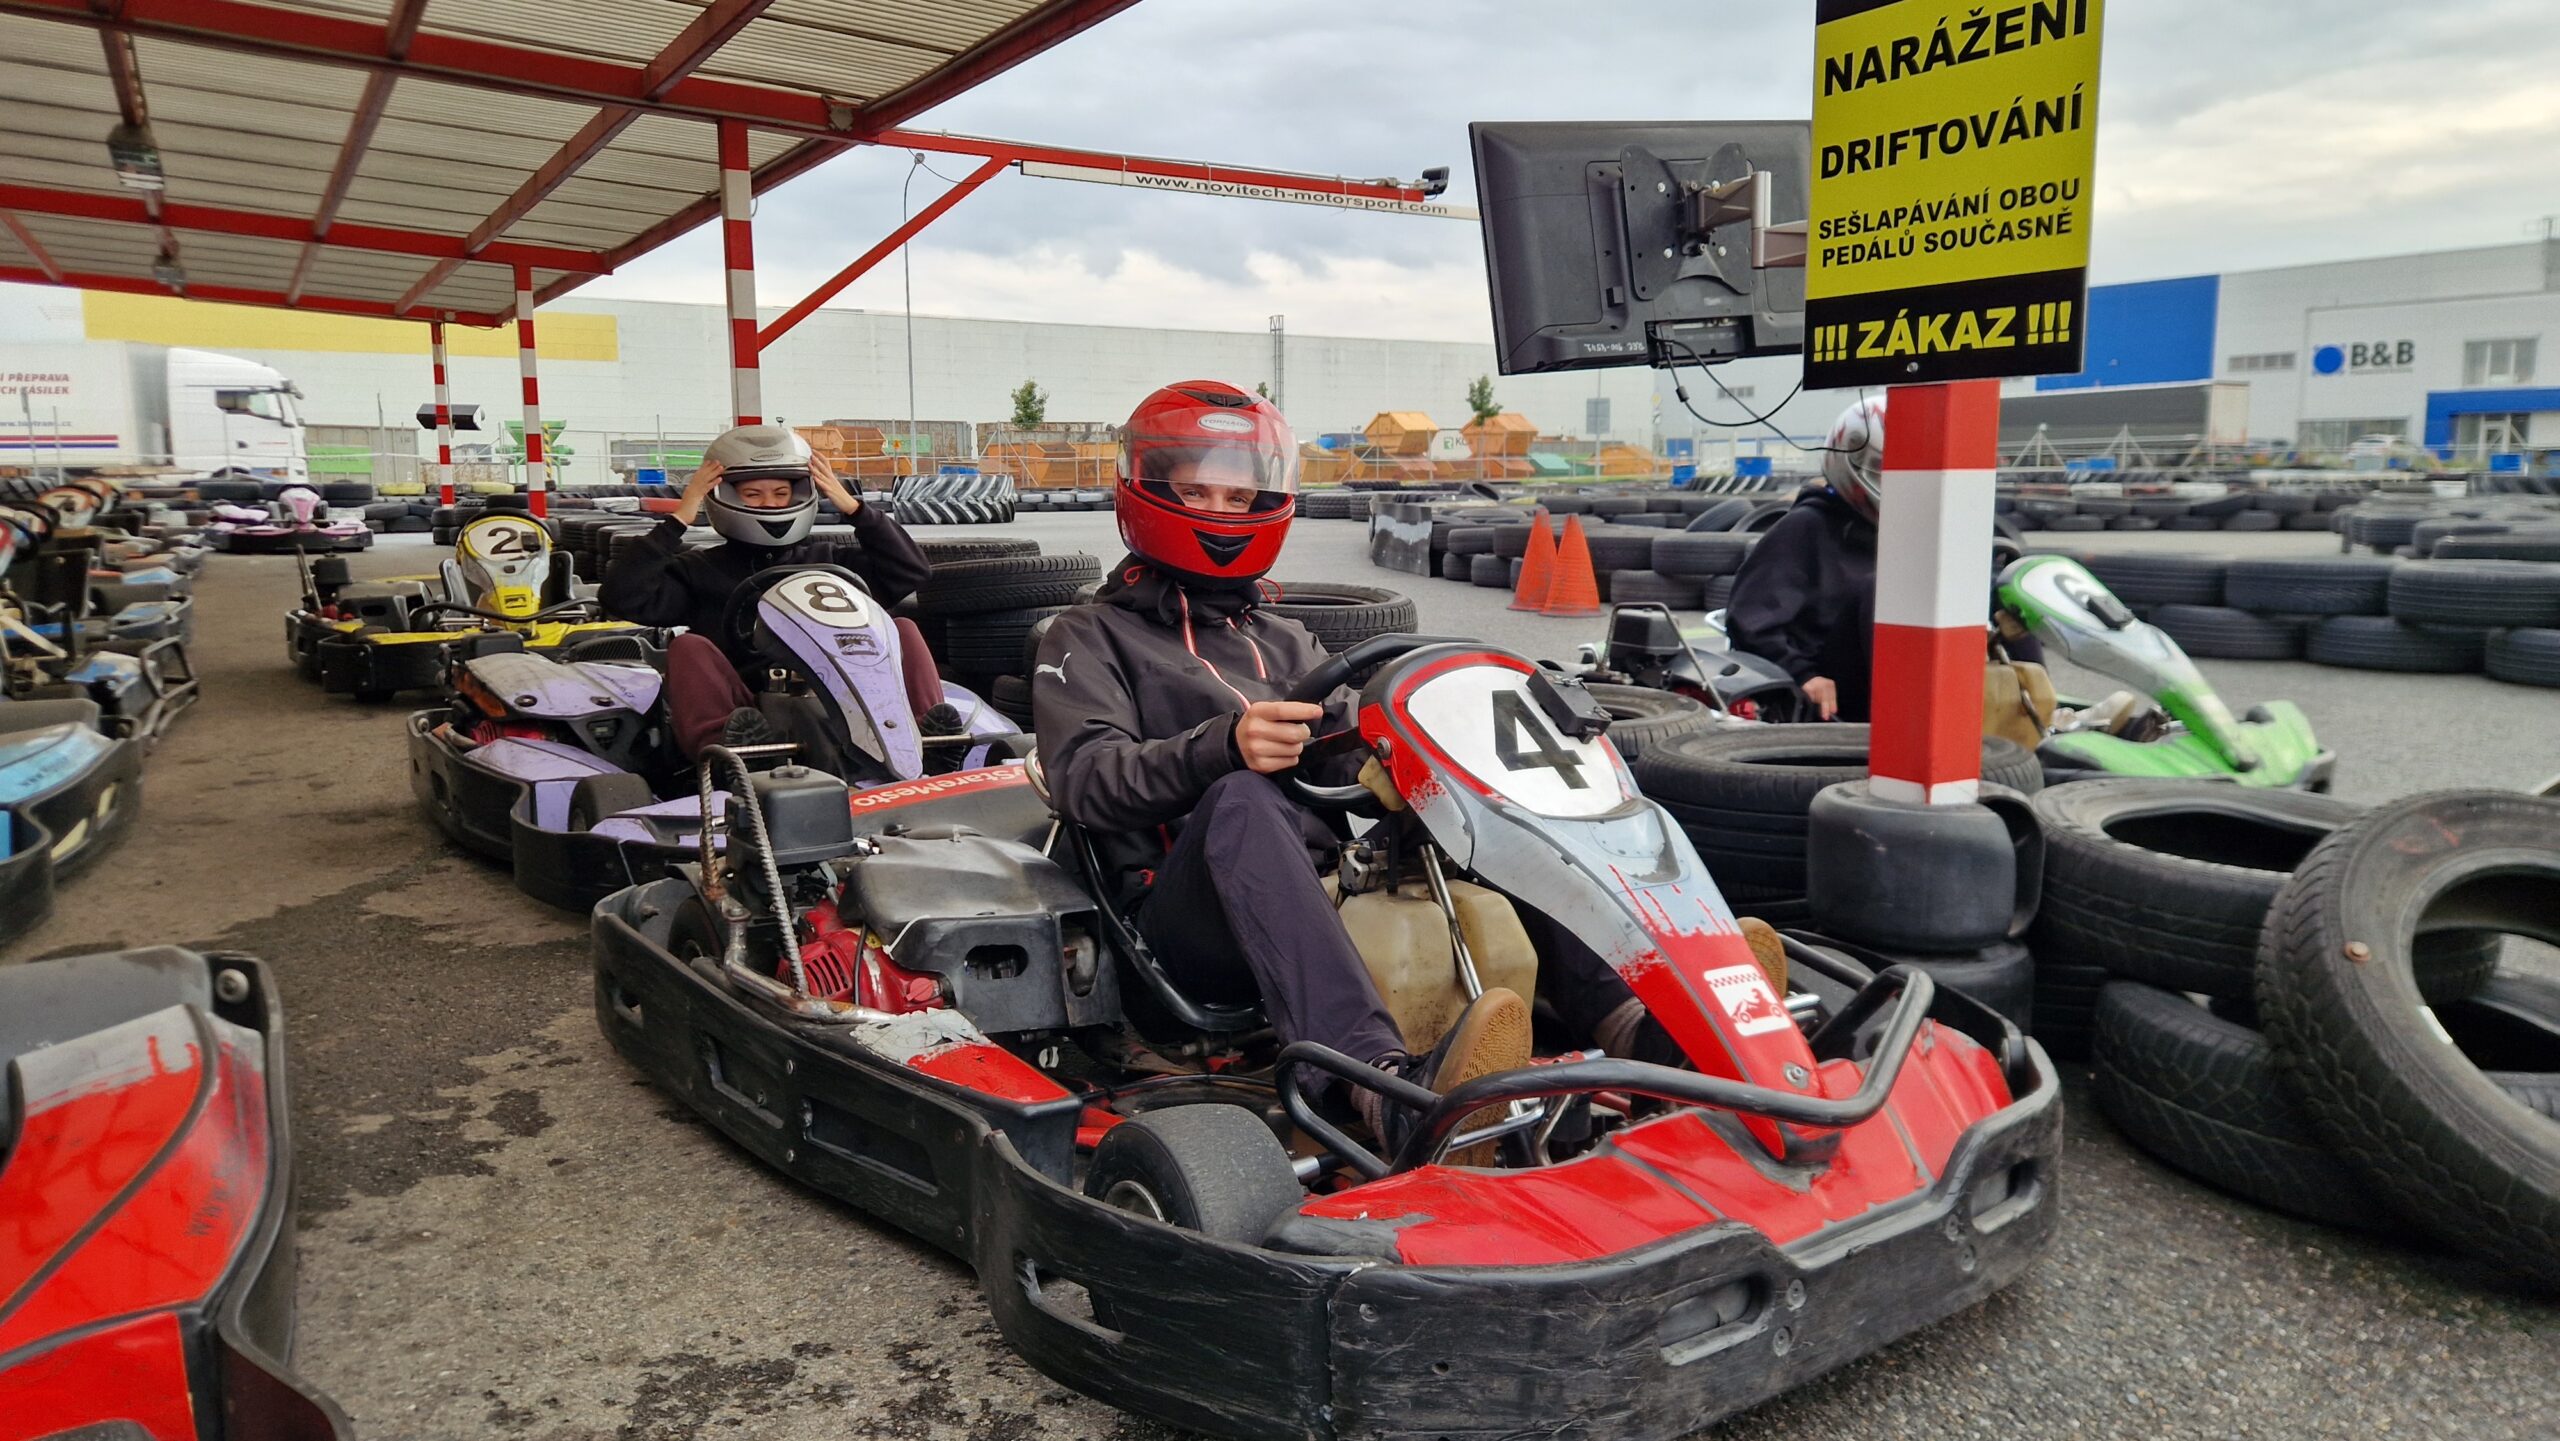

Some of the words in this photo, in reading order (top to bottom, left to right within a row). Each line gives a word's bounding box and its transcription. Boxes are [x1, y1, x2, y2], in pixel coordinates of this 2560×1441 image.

[1821, 83, 2084, 179] DRIFTOVÁNÍ
[1136, 173, 1448, 215] www.novitech-motorsport.com
[1819, 188, 1990, 240] SEŠLAPÁVÁNÍ
[1999, 178, 2081, 211] OBOU
[1822, 228, 1915, 268] PEDÁLŮ
[1923, 207, 2074, 254] SOUČASNĚ
[1812, 323, 1849, 362] !!!
[1856, 304, 2016, 359] ZÁKAZ
[2026, 301, 2072, 343] !!!
[2351, 341, 2416, 367] B&B
[8, 371, 70, 382] PŘEPRAVA
[486, 526, 524, 555] 2
[803, 581, 859, 613] 8
[1490, 689, 1590, 790] 4
